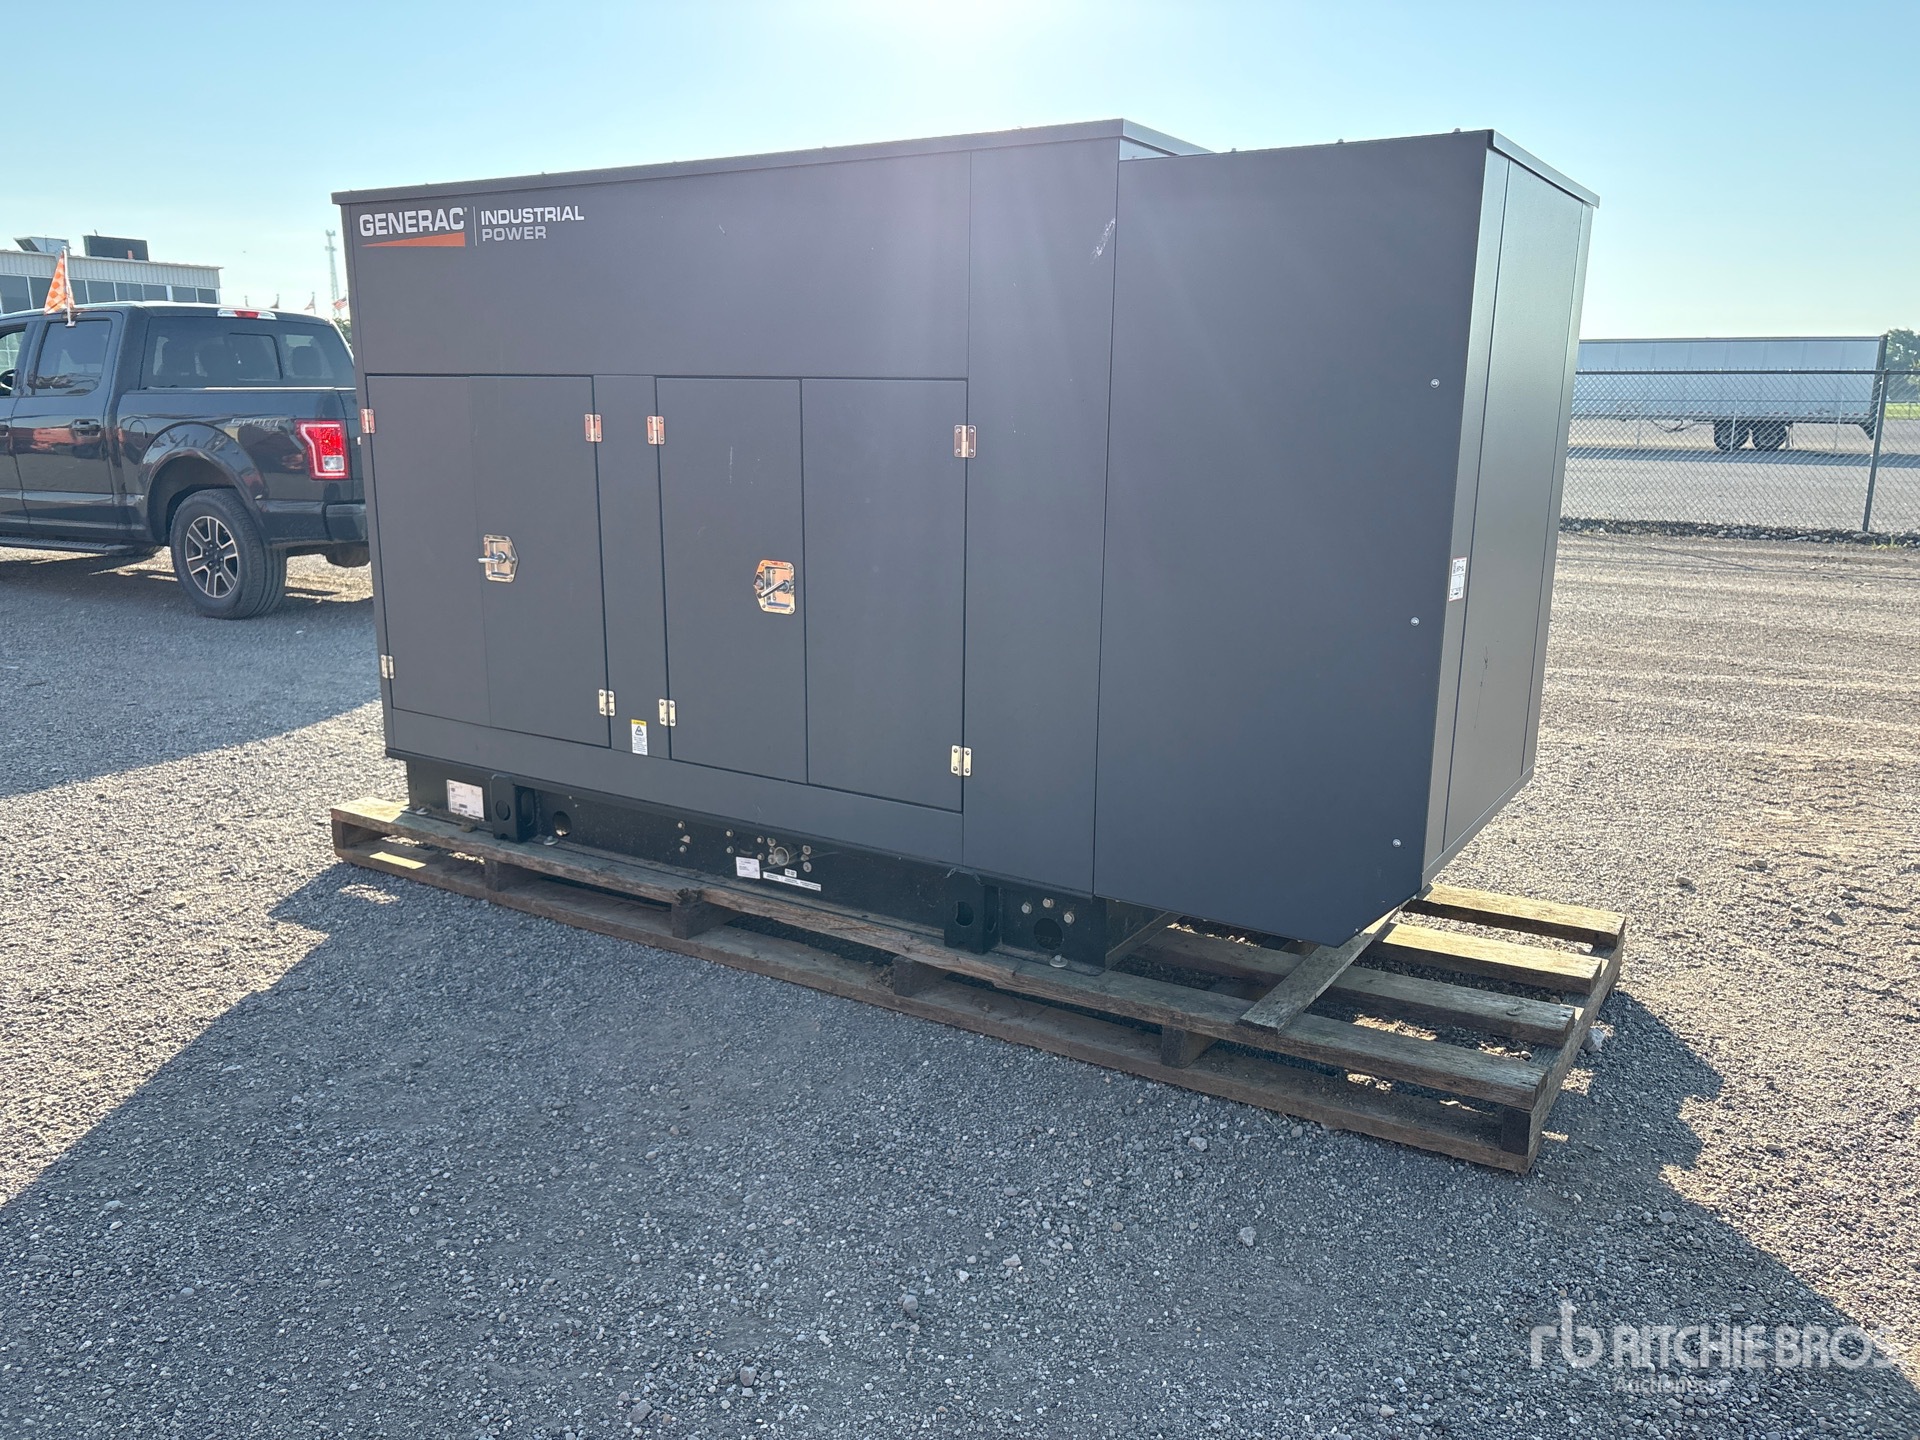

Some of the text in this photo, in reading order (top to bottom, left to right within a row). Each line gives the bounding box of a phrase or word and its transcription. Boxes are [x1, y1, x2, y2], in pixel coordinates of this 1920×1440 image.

[359, 207, 465, 237] GENERAC
[480, 205, 585, 226] INDUSTRIAL
[482, 225, 547, 242] POWER
